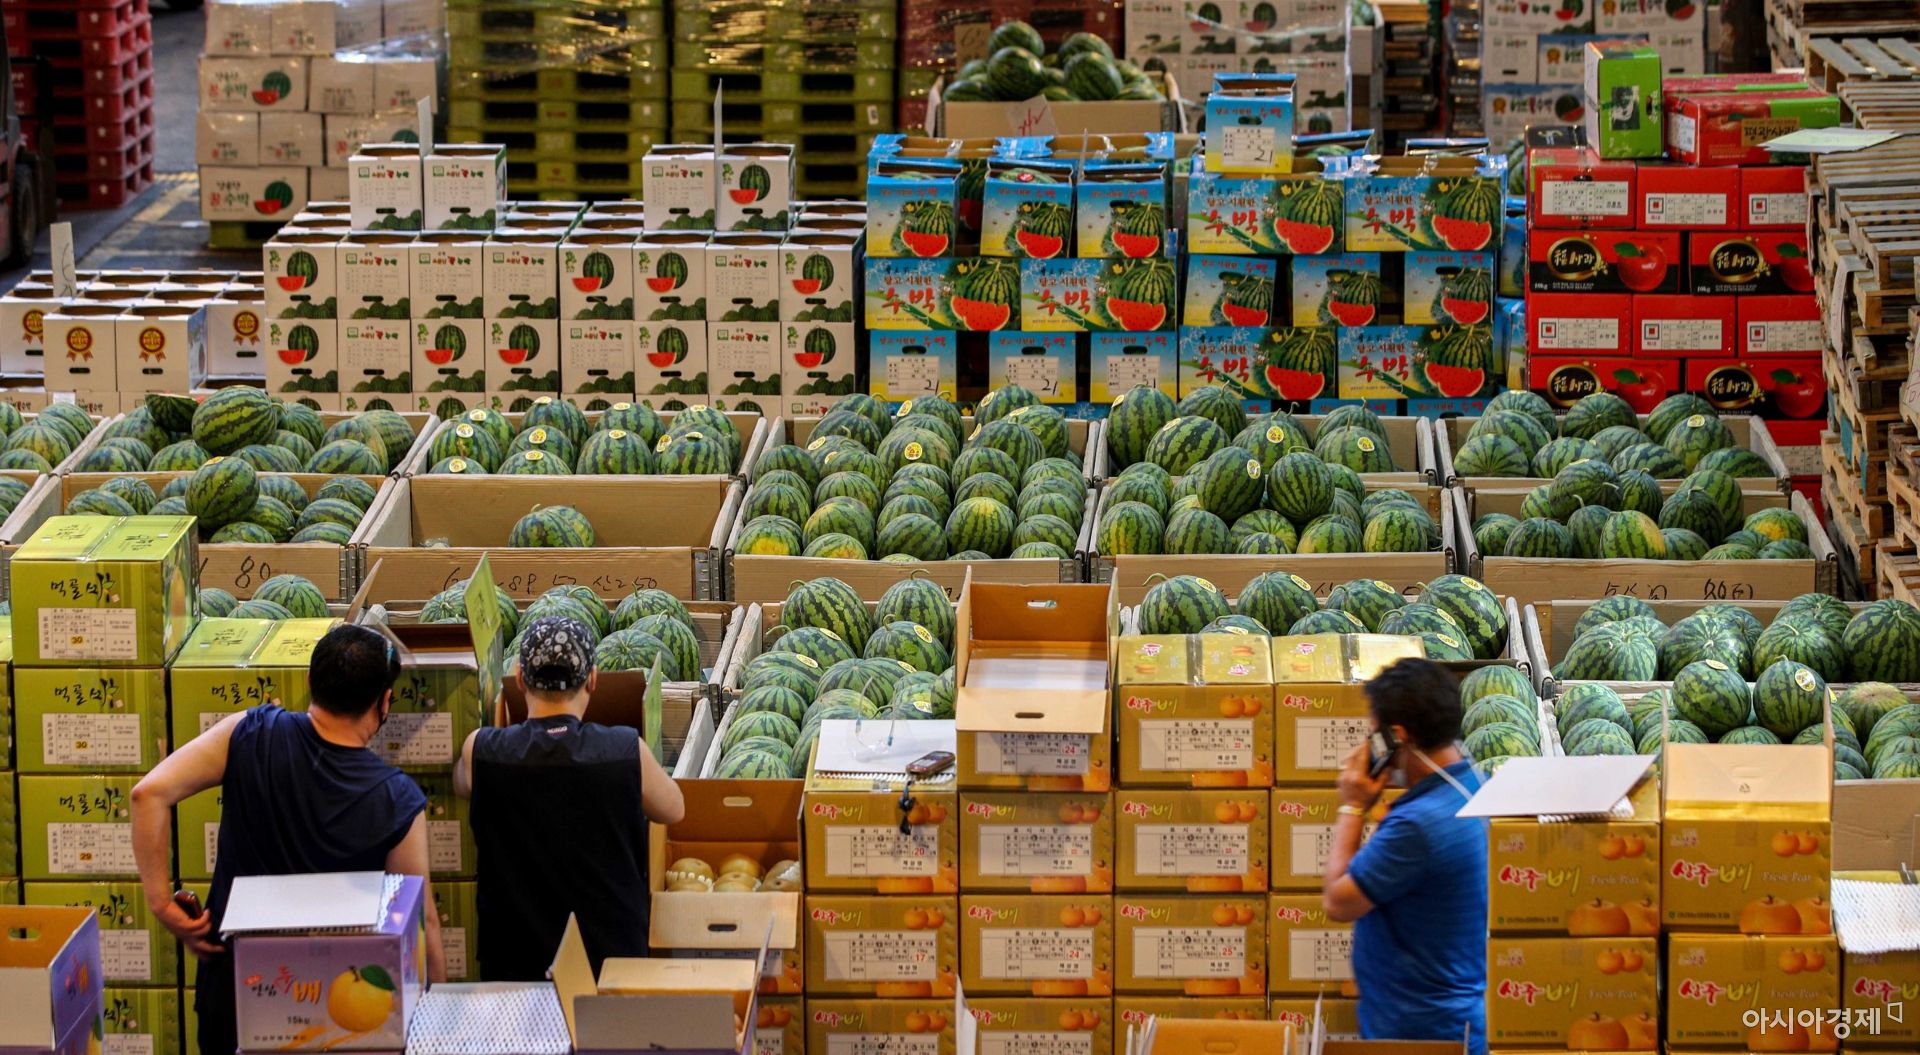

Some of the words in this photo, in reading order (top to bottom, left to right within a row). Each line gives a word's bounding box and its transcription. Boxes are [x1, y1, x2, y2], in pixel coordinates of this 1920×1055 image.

[1203, 206, 1259, 238] 수박
[1361, 206, 1416, 236] 수박
[881, 286, 936, 317] 수박
[1036, 287, 1091, 318] 수박
[1195, 355, 1250, 384] 수박
[1355, 353, 1410, 383] 수박
